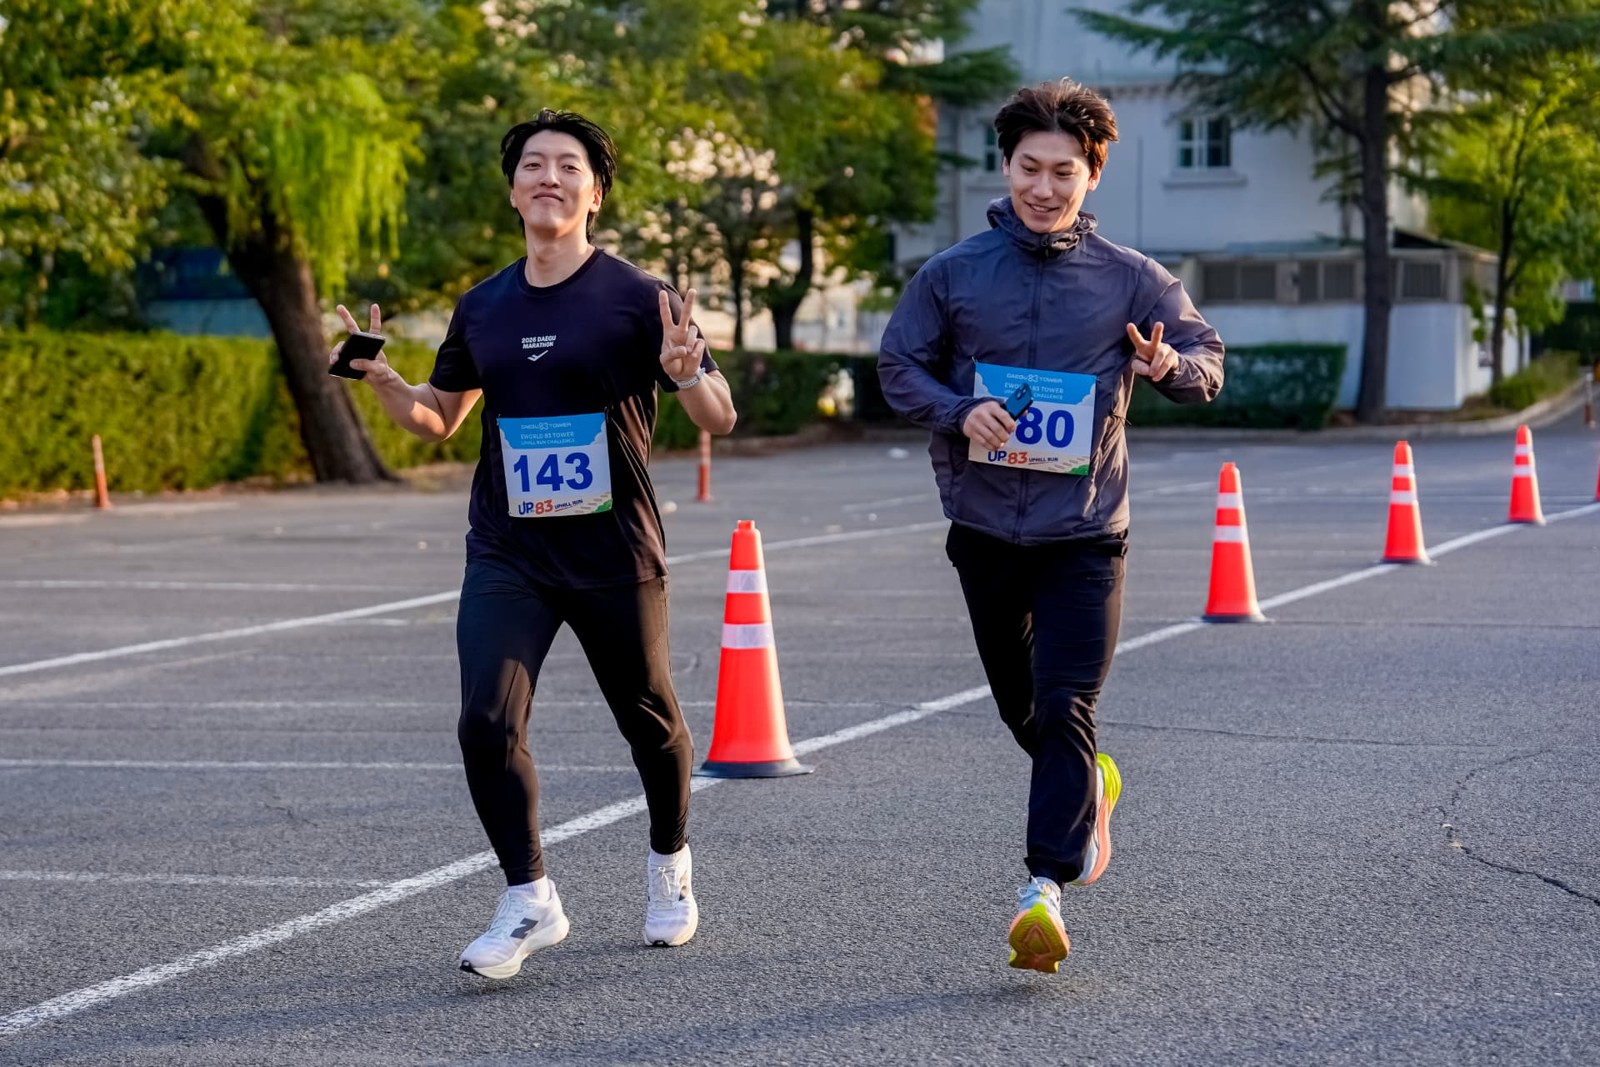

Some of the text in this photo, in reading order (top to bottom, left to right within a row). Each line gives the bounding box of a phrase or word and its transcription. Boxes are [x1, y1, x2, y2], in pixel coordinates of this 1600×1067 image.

[522, 341, 554, 349] MARATHON
[537, 334, 557, 342] DAEGU
[1027, 374, 1039, 382] 83
[1010, 406, 1075, 448] 80
[988, 450, 1007, 462] UP
[1007, 451, 1028, 465] 83
[514, 452, 593, 492] 143
[518, 501, 534, 515] UP
[535, 499, 553, 515] 83
